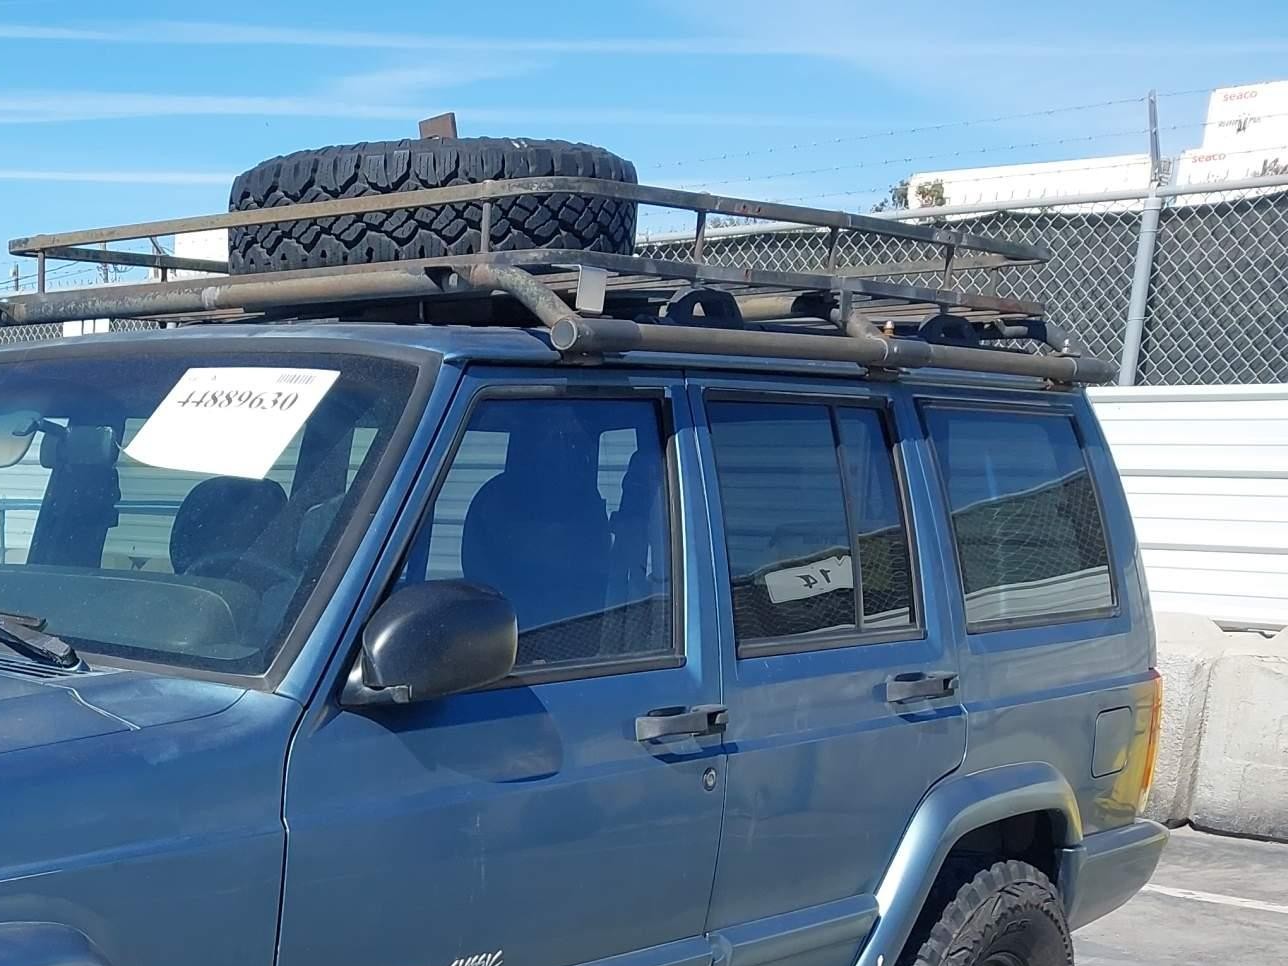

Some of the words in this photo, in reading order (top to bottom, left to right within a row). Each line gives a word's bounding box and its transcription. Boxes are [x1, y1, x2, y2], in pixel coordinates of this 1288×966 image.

[1223, 90, 1258, 102] seaco
[1191, 153, 1226, 163] seaco
[177, 389, 299, 411] 44889630
